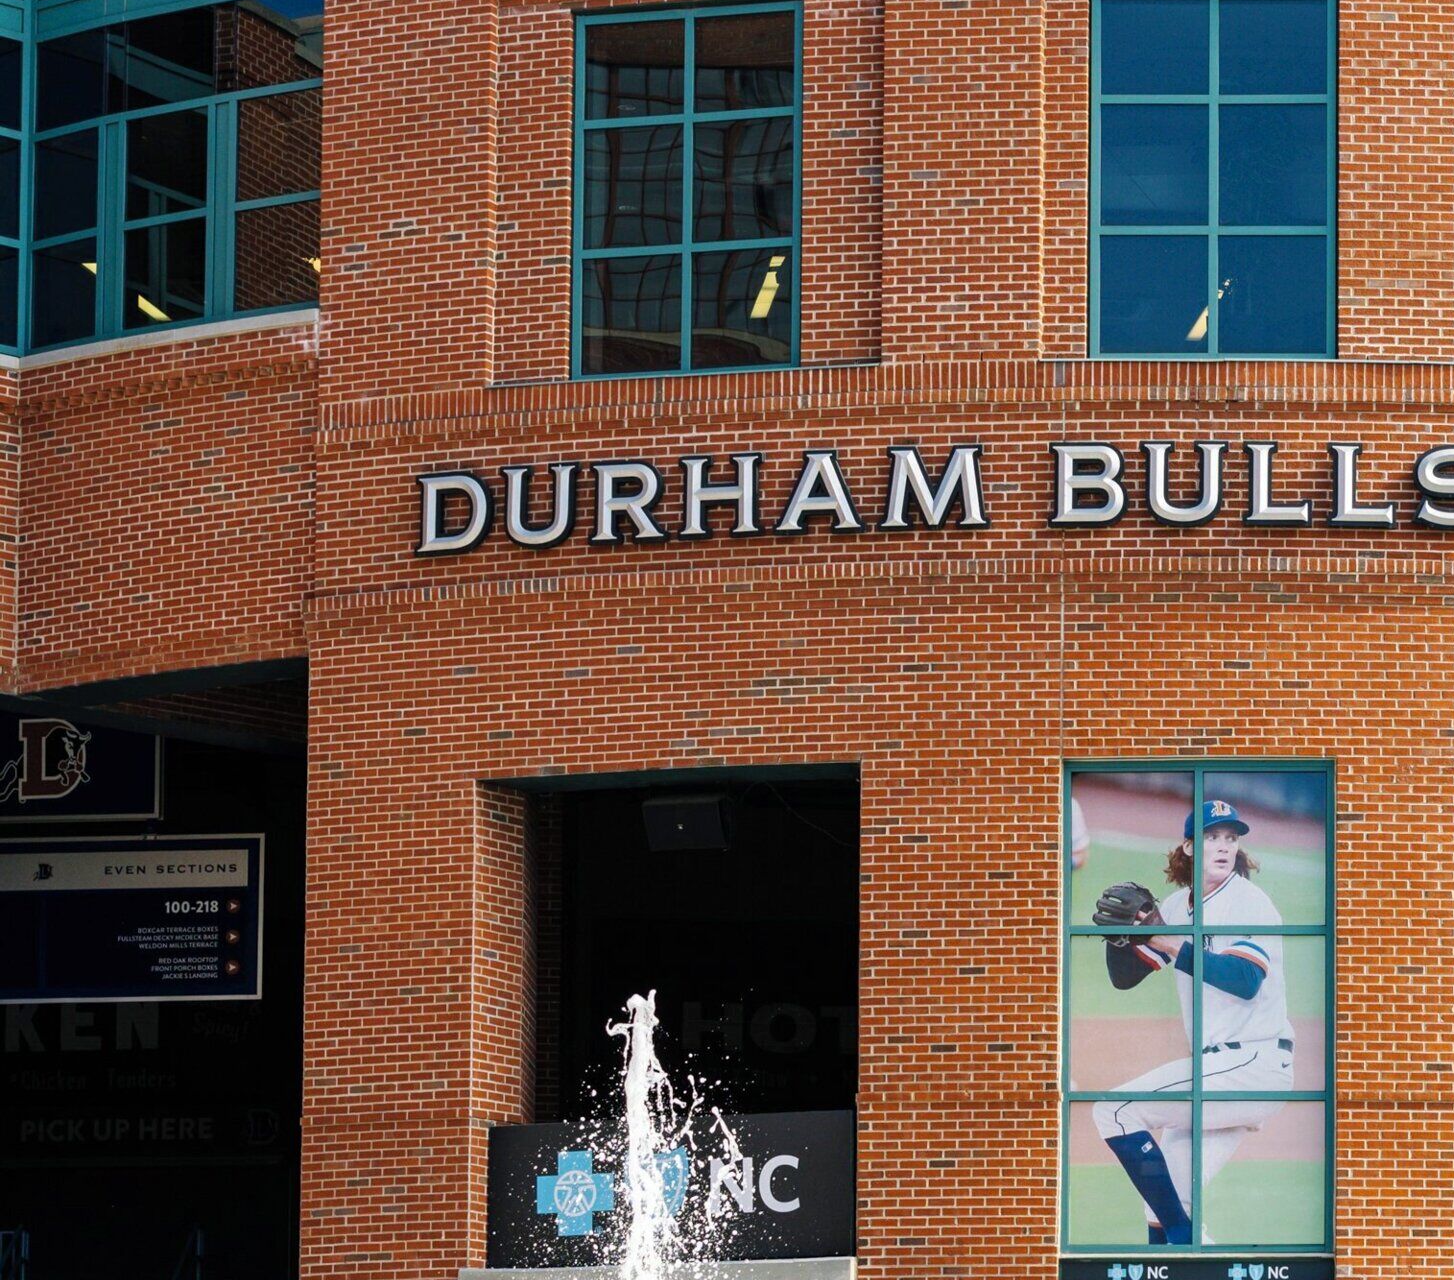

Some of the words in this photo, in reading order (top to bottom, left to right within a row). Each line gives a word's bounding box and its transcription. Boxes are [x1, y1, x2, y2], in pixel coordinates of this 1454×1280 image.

[415, 444, 991, 557] DURHAM
[104, 866, 146, 875] EVEN
[156, 864, 238, 874] SECTIONS
[164, 901, 219, 914] 100-218
[20, 1118, 86, 1142] PICK
[93, 1118, 130, 1142] UP
[138, 1116, 215, 1141] HERE
[709, 1154, 801, 1214] NC
[1147, 1266, 1169, 1280] NC
[1267, 1266, 1290, 1280] NC
